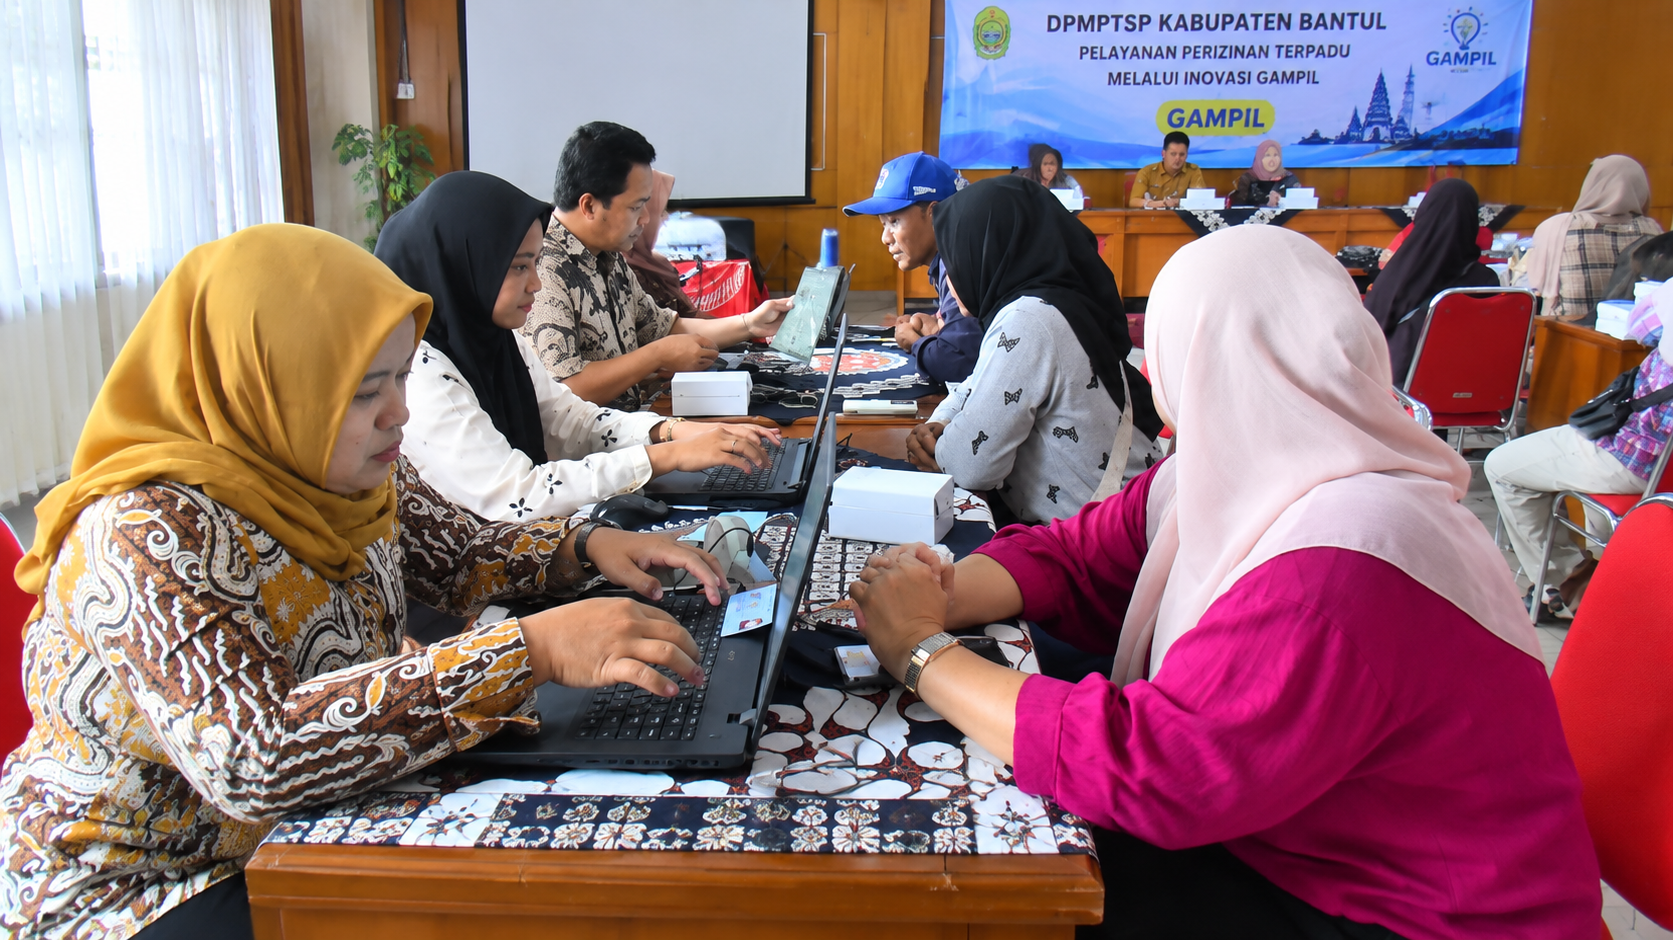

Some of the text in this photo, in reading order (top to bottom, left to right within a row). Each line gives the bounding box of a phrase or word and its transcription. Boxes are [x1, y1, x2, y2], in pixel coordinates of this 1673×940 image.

[1047, 12, 1387, 33] DPMPTSP KABUPATEN BANTUL
[1079, 44, 1351, 60] PELAYANAN PERIZINAN TERPADU
[1426, 50, 1497, 67] GAMPIL
[1107, 70, 1320, 86] MELALUI INOVASI GAMPIL
[1167, 107, 1265, 129] GAMPIL
